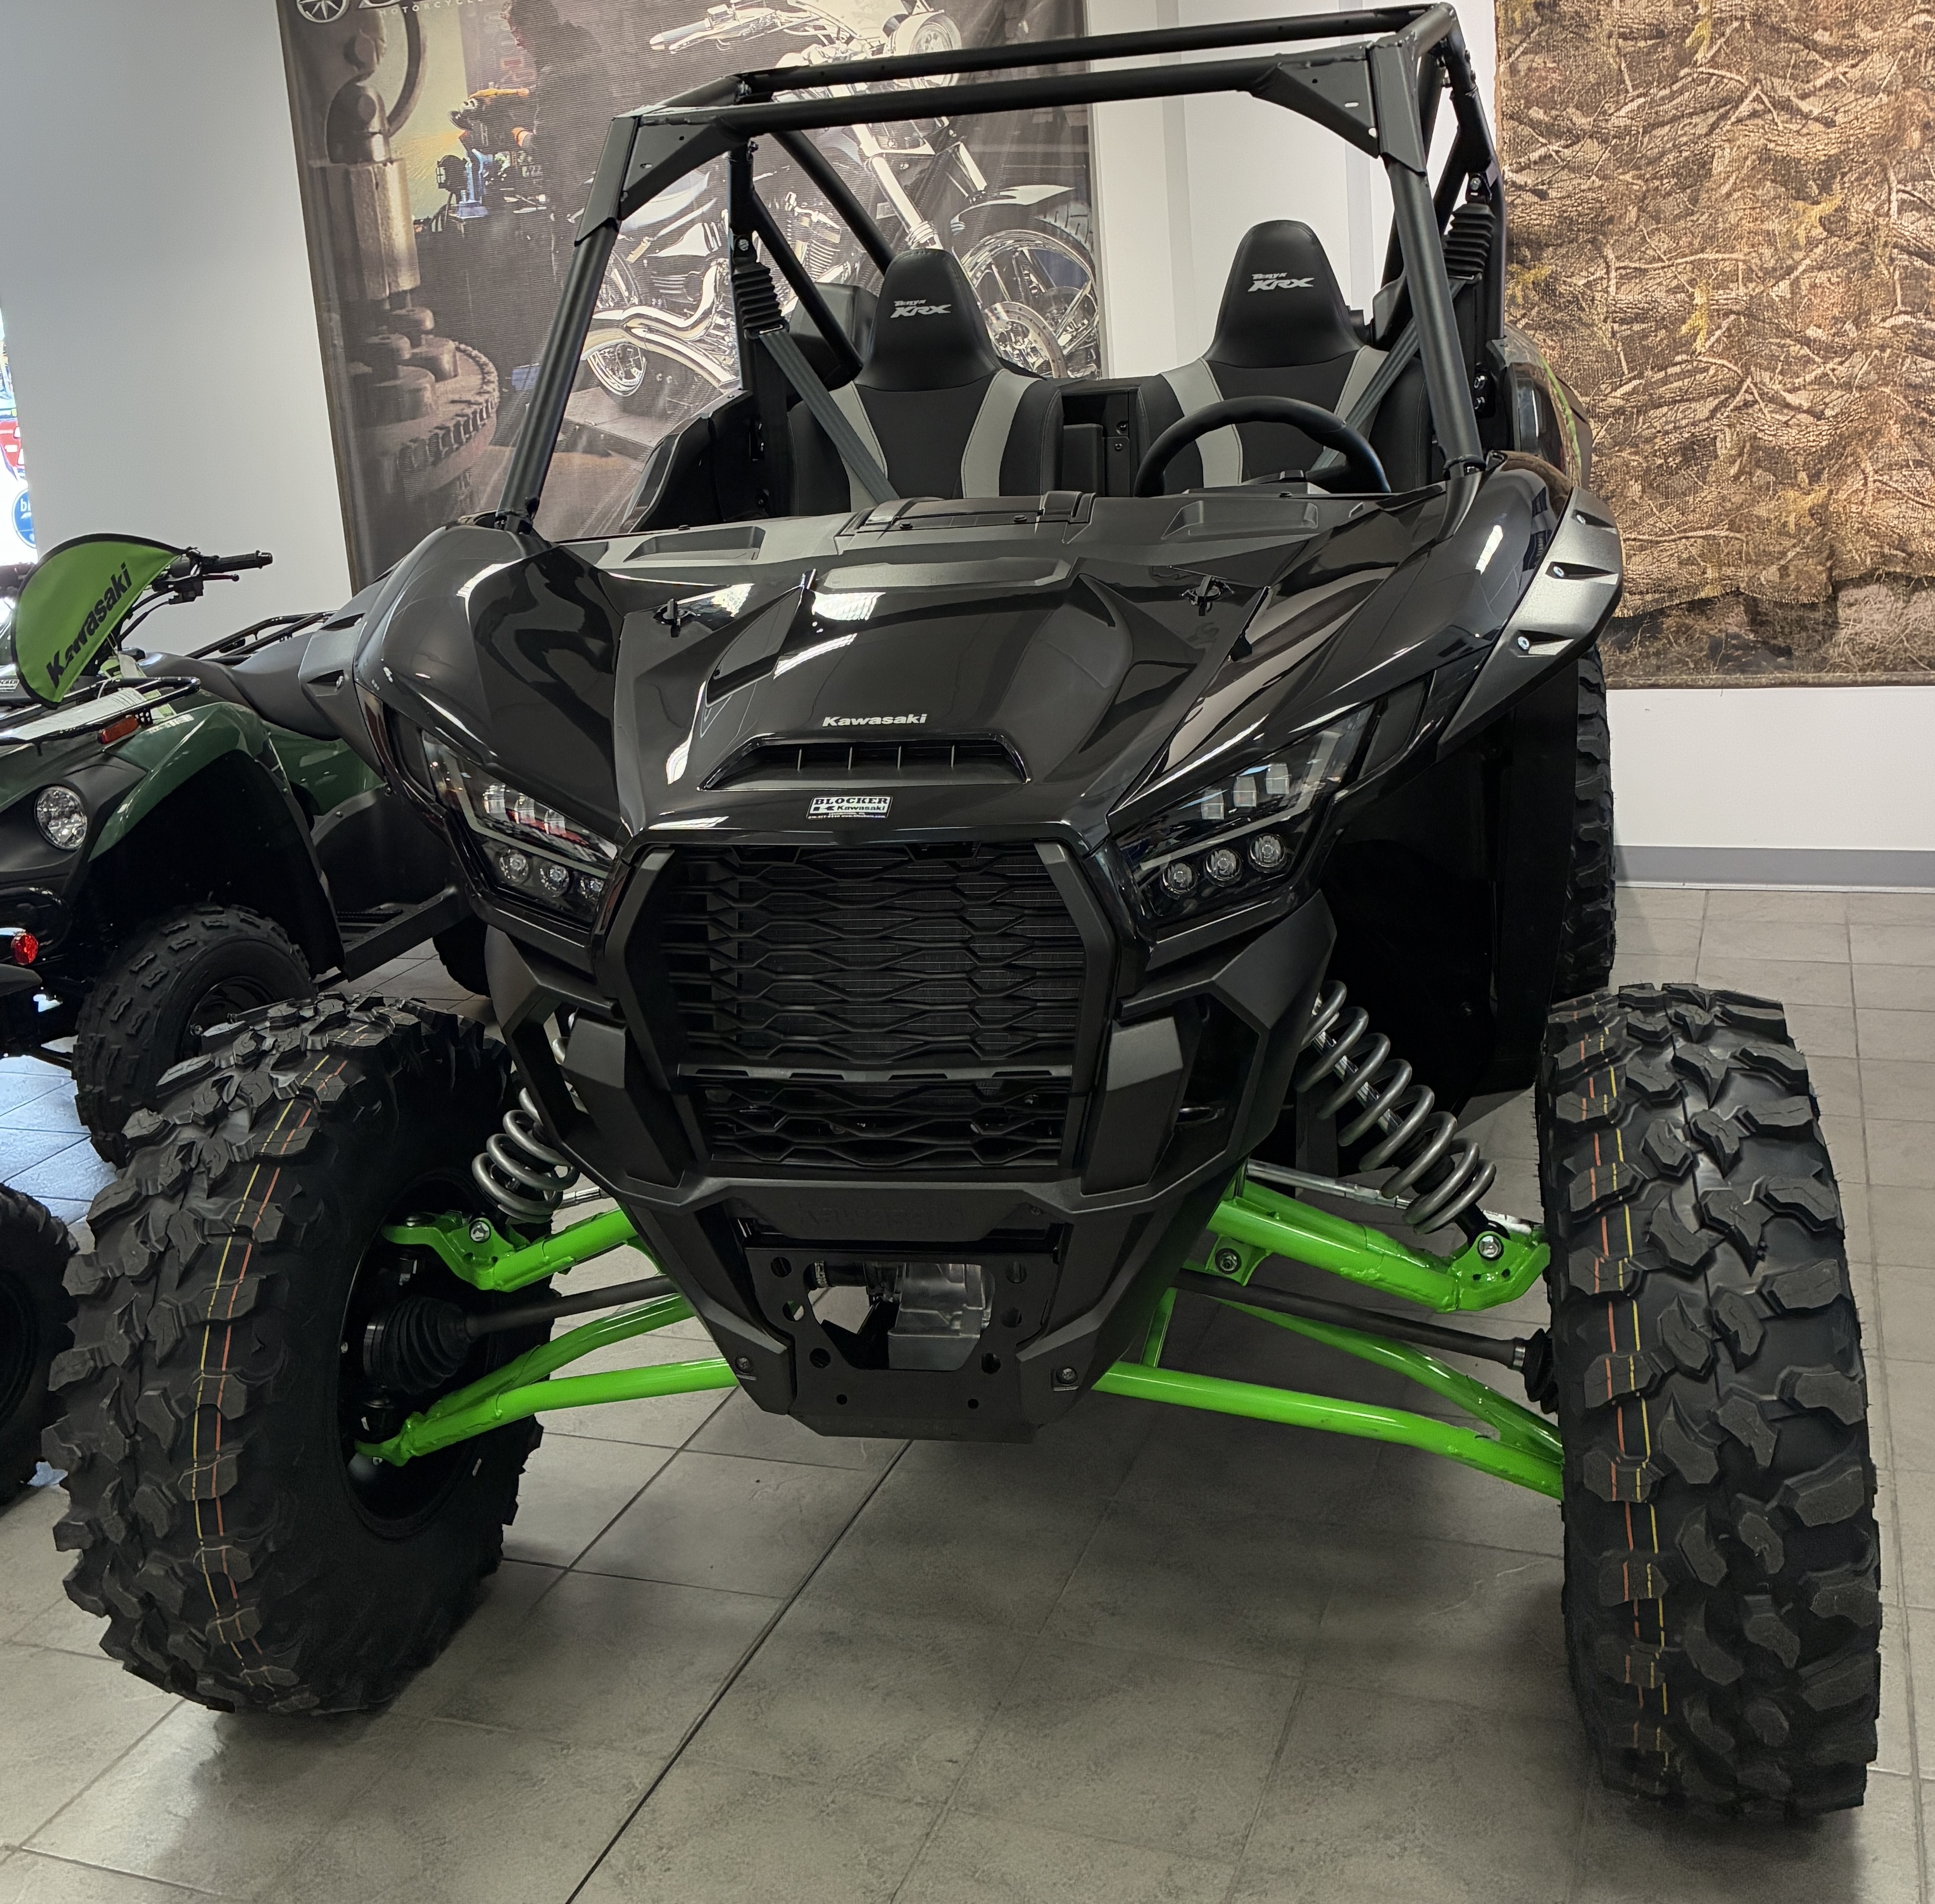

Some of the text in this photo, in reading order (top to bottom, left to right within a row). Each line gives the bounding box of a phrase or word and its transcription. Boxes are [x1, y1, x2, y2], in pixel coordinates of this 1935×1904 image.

[1248, 278, 1315, 292] KRX
[890, 304, 951, 318] KRX
[821, 713, 928, 727] Kawasaki
[813, 797, 888, 805] BLOCKER
